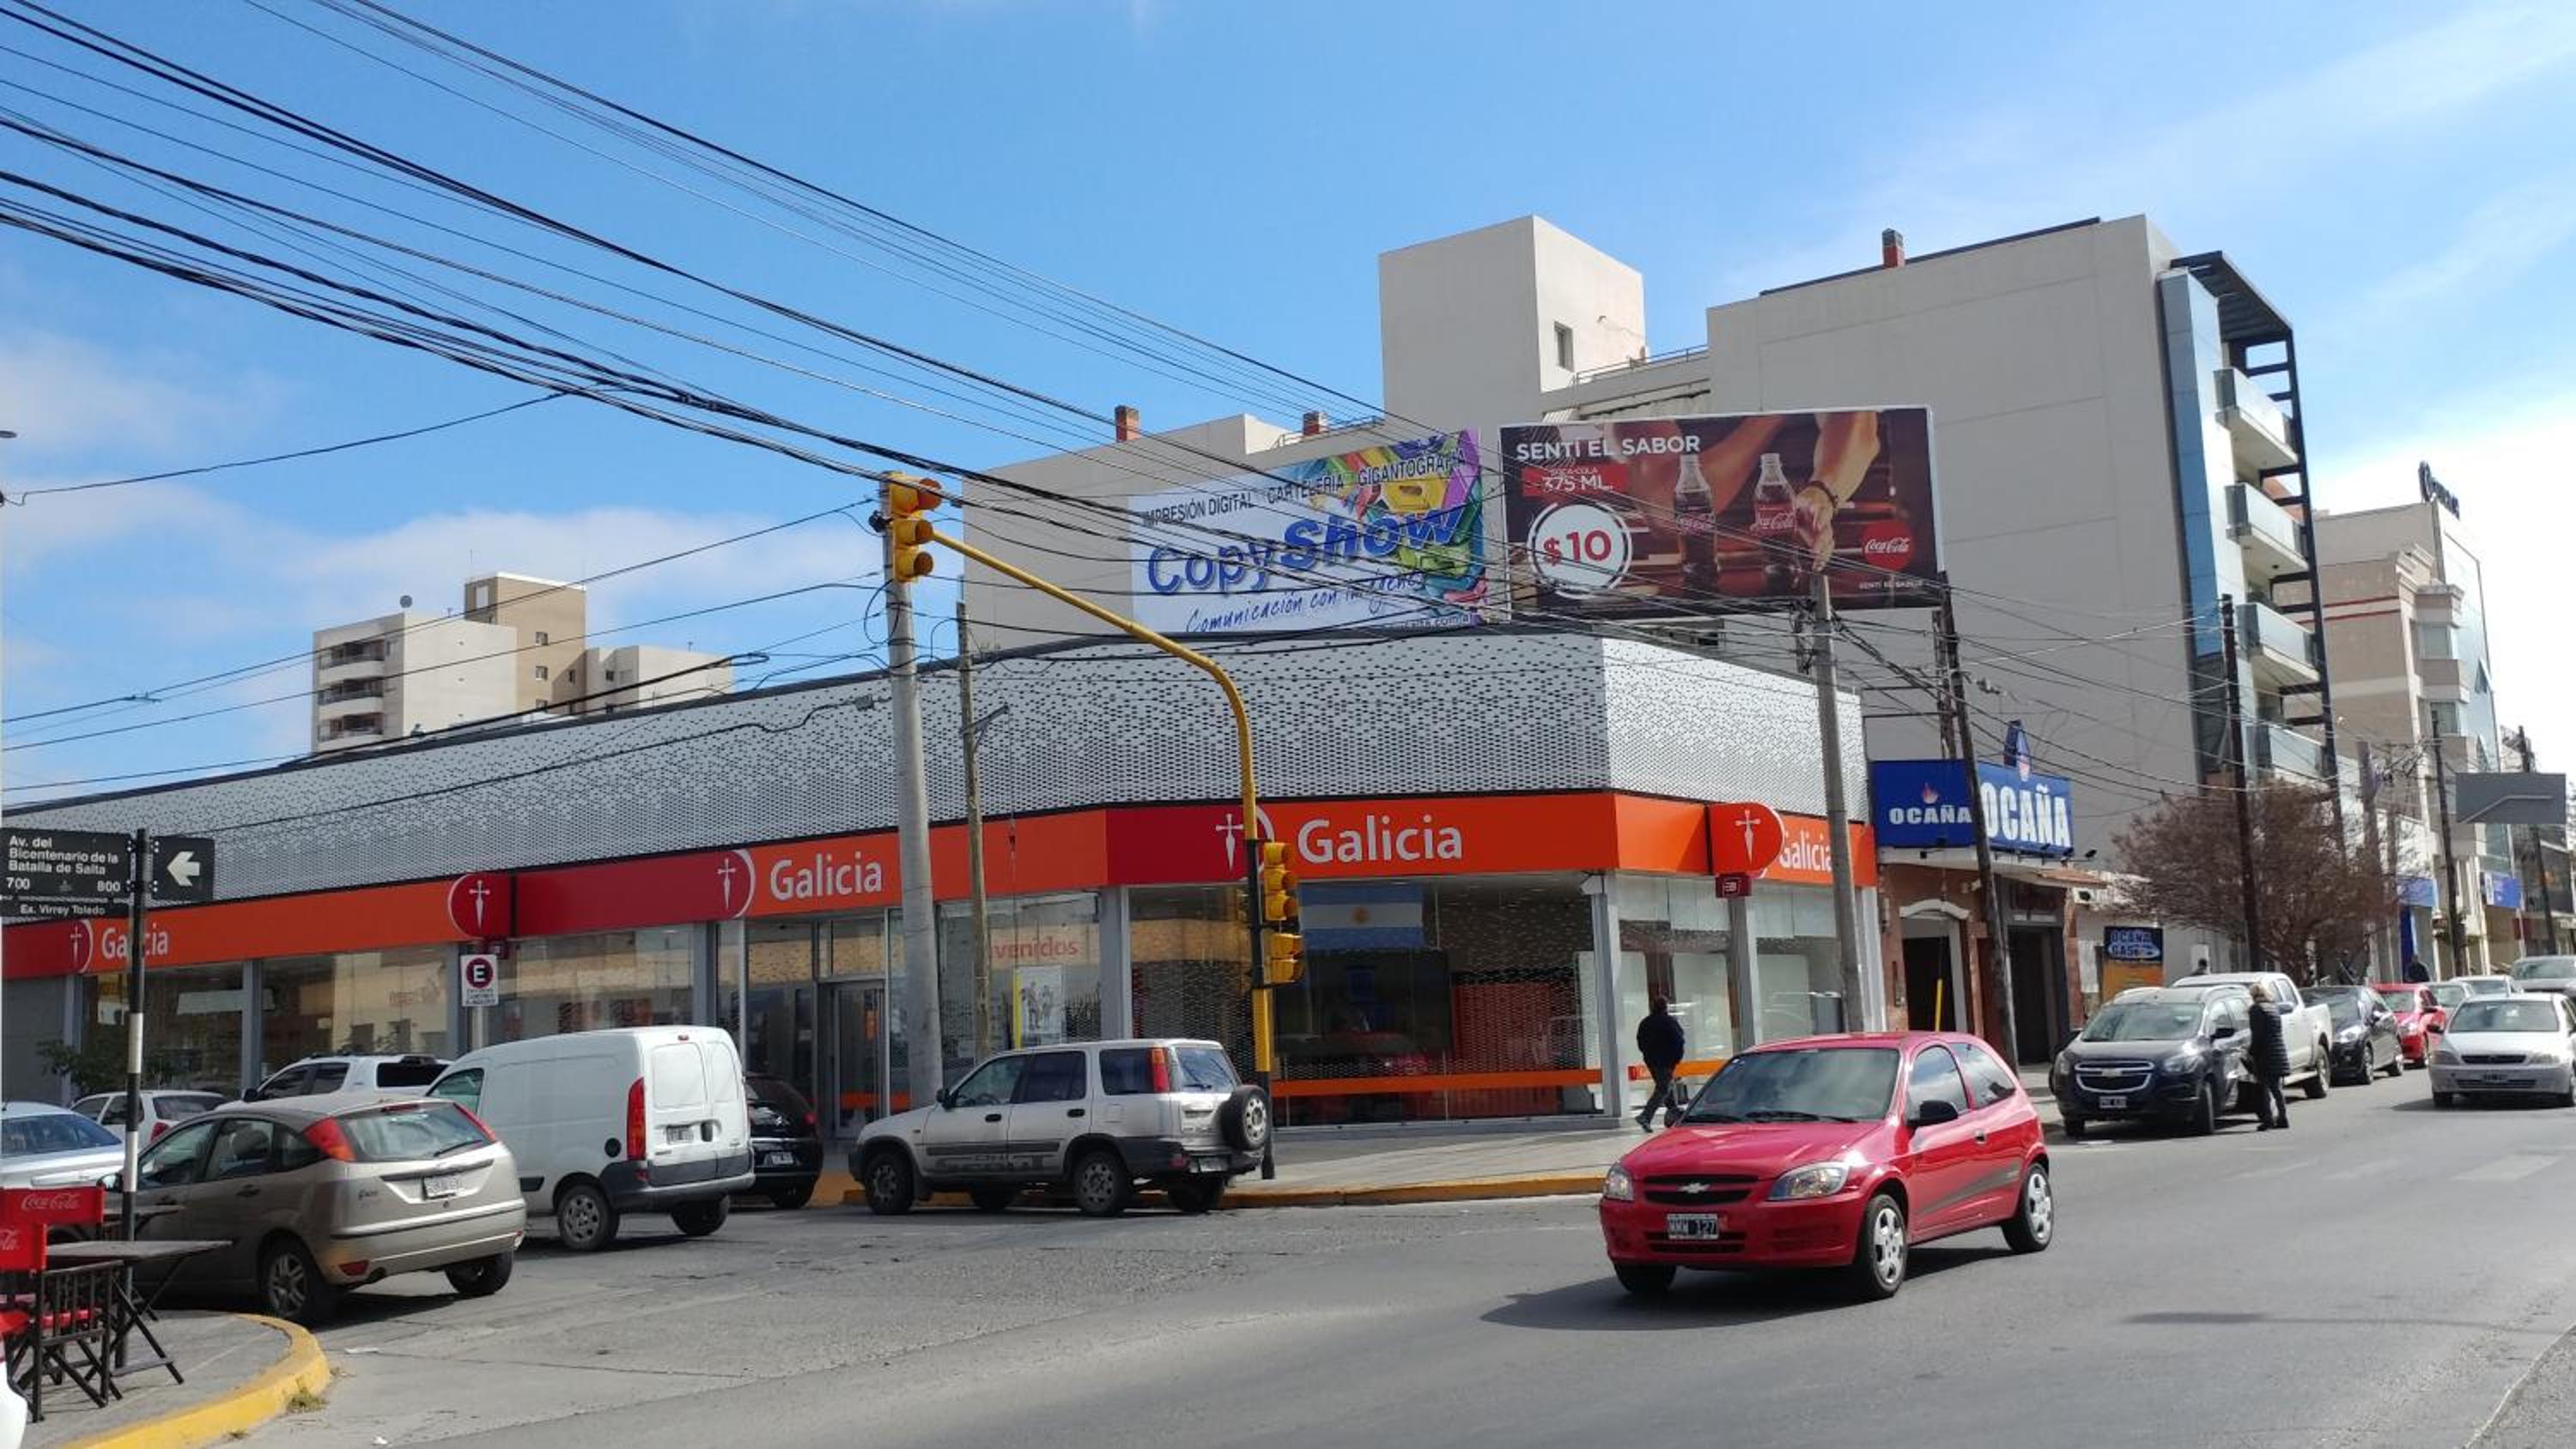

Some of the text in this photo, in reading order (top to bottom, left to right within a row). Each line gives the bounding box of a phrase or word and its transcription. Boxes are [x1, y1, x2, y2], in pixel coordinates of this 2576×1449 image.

[1589, 440, 1617, 456] EL
[1622, 436, 1700, 455] SABOR
[1542, 476, 1577, 494] 375
[1208, 492, 1252, 516] DIGITAL
[1543, 529, 1612, 566] $10
[1147, 543, 1273, 596] Copy
[1187, 589, 1303, 633] Comunicación
[1310, 588, 1338, 608] con
[1889, 804, 1972, 824] OCAÑA
[1980, 782, 2071, 847] OCAÑA
[9, 835, 52, 848] Av. del
[1297, 815, 1463, 864] Galicia
[9, 848, 119, 864] Bicentenario de la
[8, 860, 106, 875] Batalla de Salta
[770, 852, 883, 900] Galicia
[6, 877, 121, 892] 700 800
[40, 904, 70, 917] Virrey
[73, 904, 106, 916] Toledo
[473, 964, 486, 983] E
